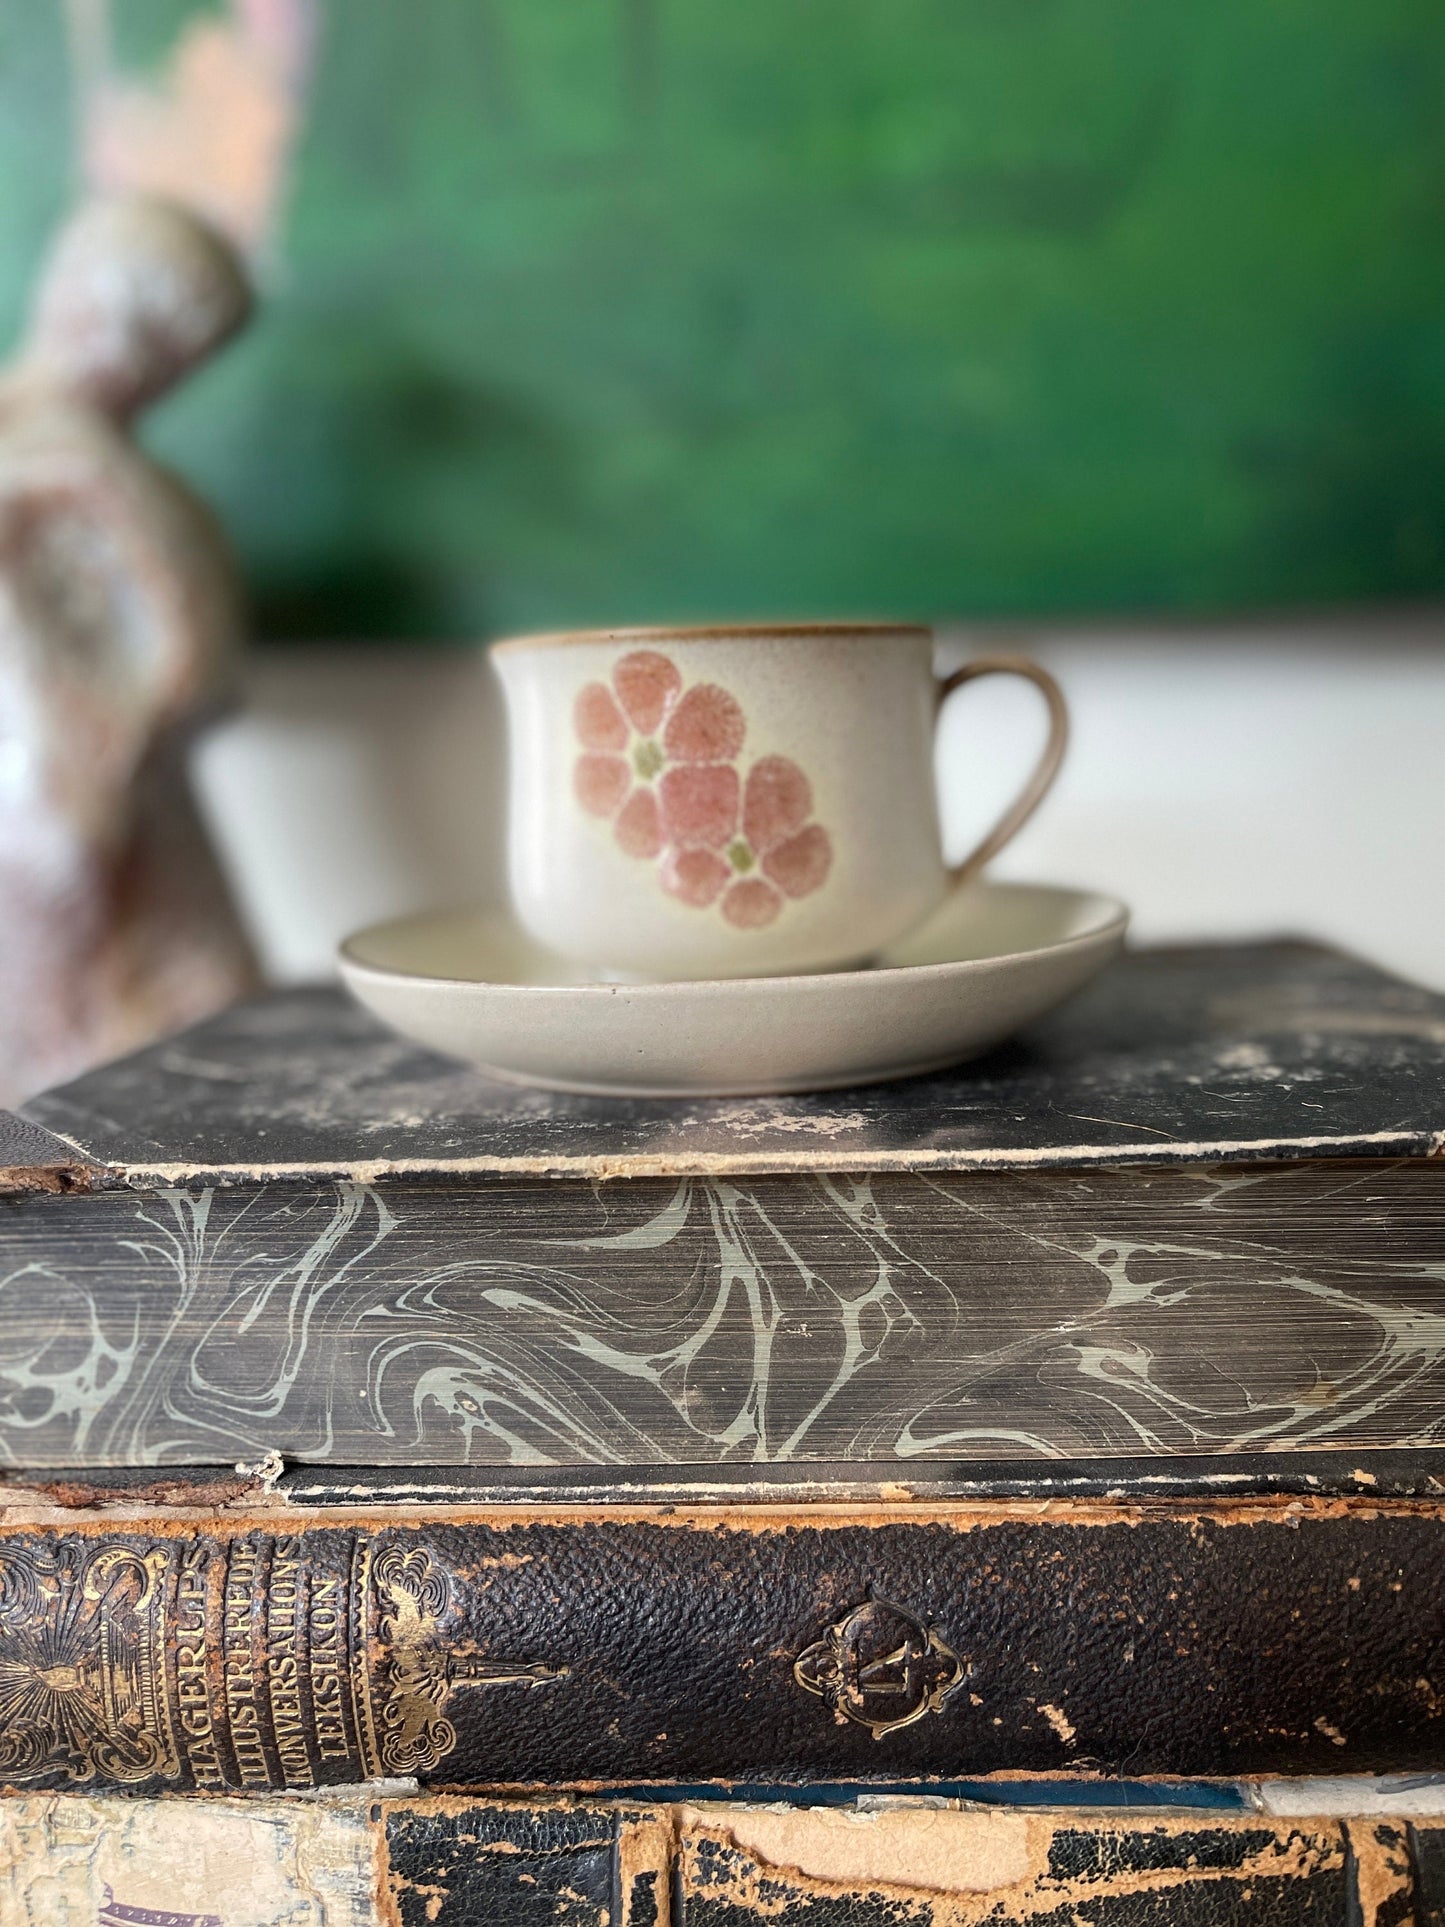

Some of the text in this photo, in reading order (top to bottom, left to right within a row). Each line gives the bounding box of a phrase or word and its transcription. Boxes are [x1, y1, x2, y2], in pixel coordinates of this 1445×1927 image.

[177, 1545, 225, 1789] HAGERUPS
[226, 1542, 269, 1787] ILLUSTREREDE
[268, 1537, 314, 1787] KONVERSATIONS
[310, 1577, 351, 1761] LEKSIKON
